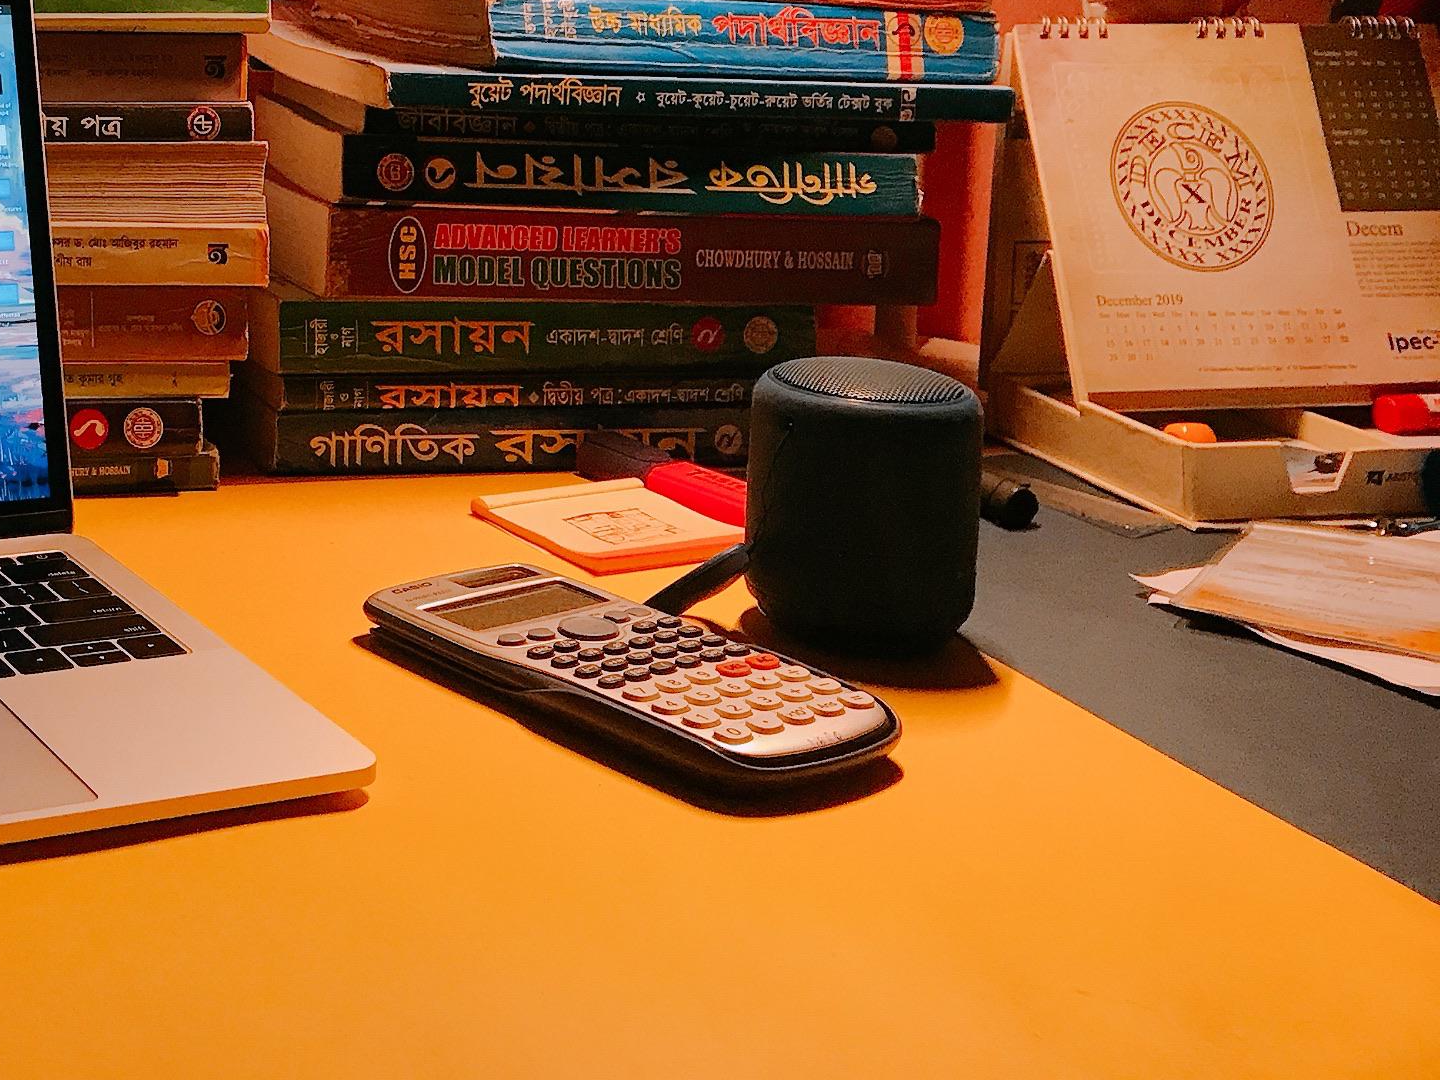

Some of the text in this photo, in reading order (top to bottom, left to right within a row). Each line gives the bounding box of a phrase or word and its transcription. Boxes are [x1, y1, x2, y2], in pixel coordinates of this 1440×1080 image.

[587, 3, 883, 51] উচ্চ মাধ্যমিক পদার্থবিজ্ঞান
[468, 77, 622, 108] বুয়েট পদার্থবিজ্ঞান
[656, 90, 799, 111] বুয়েট-কুয়েট-চুয়েট-রুয়েট
[801, 91, 834, 110] ভর্তির
[837, 91, 870, 111] টেক্সট
[874, 95, 894, 114] বুক
[80, 114, 124, 139] পত্র
[462, 151, 878, 206] গাণিতিক রসায়ন
[1181, 183, 1207, 204] X
[433, 223, 682, 255] ADVANCED LEARNER'S
[1346, 220, 1404, 237] Decem
[148, 238, 180, 249] রহমান
[398, 224, 417, 280] HSC
[432, 255, 682, 290] MODEL QUESTIONS
[695, 249, 855, 271] CHOWDHURY & HOSSAIN
[1095, 293, 1184, 307] December 2019
[370, 316, 683, 355] রসায়ন একাদশ-দ্বাদশ শ্রেণি
[375, 380, 525, 409] রসায়ন
[542, 381, 584, 407] দ্বিতীয়
[624, 386, 710, 405] একাদশ-দ্বাদশ
[713, 385, 745, 405] শ্রেণি
[309, 423, 480, 468] গাণিতিক
[391, 581, 433, 595] CASIO
[92, 606, 122, 614] return
